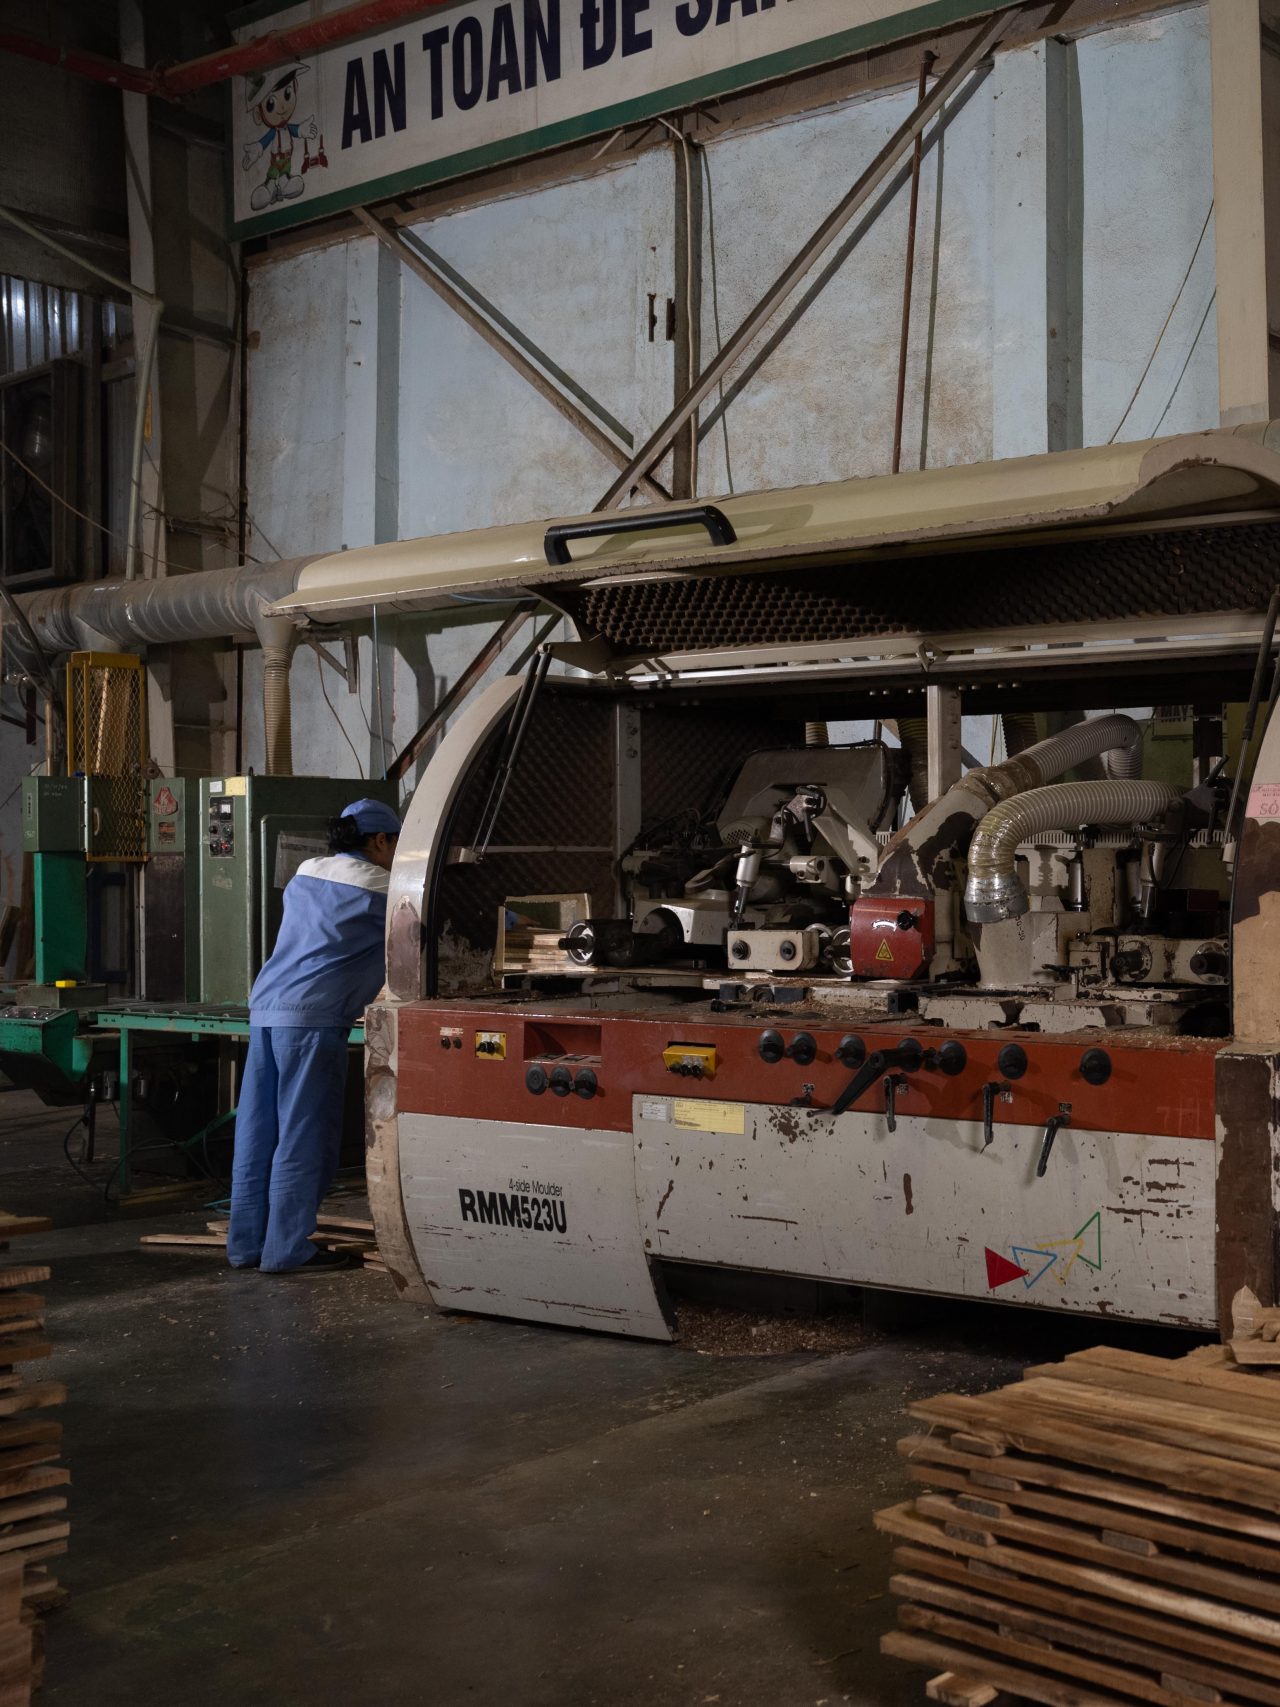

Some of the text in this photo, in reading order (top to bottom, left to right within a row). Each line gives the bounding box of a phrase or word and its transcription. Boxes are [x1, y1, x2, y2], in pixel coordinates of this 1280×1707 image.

[342, 41, 406, 150] AN
[509, 1178, 563, 1197] 4-side Moulder
[458, 1188, 567, 1234] RMM523U
